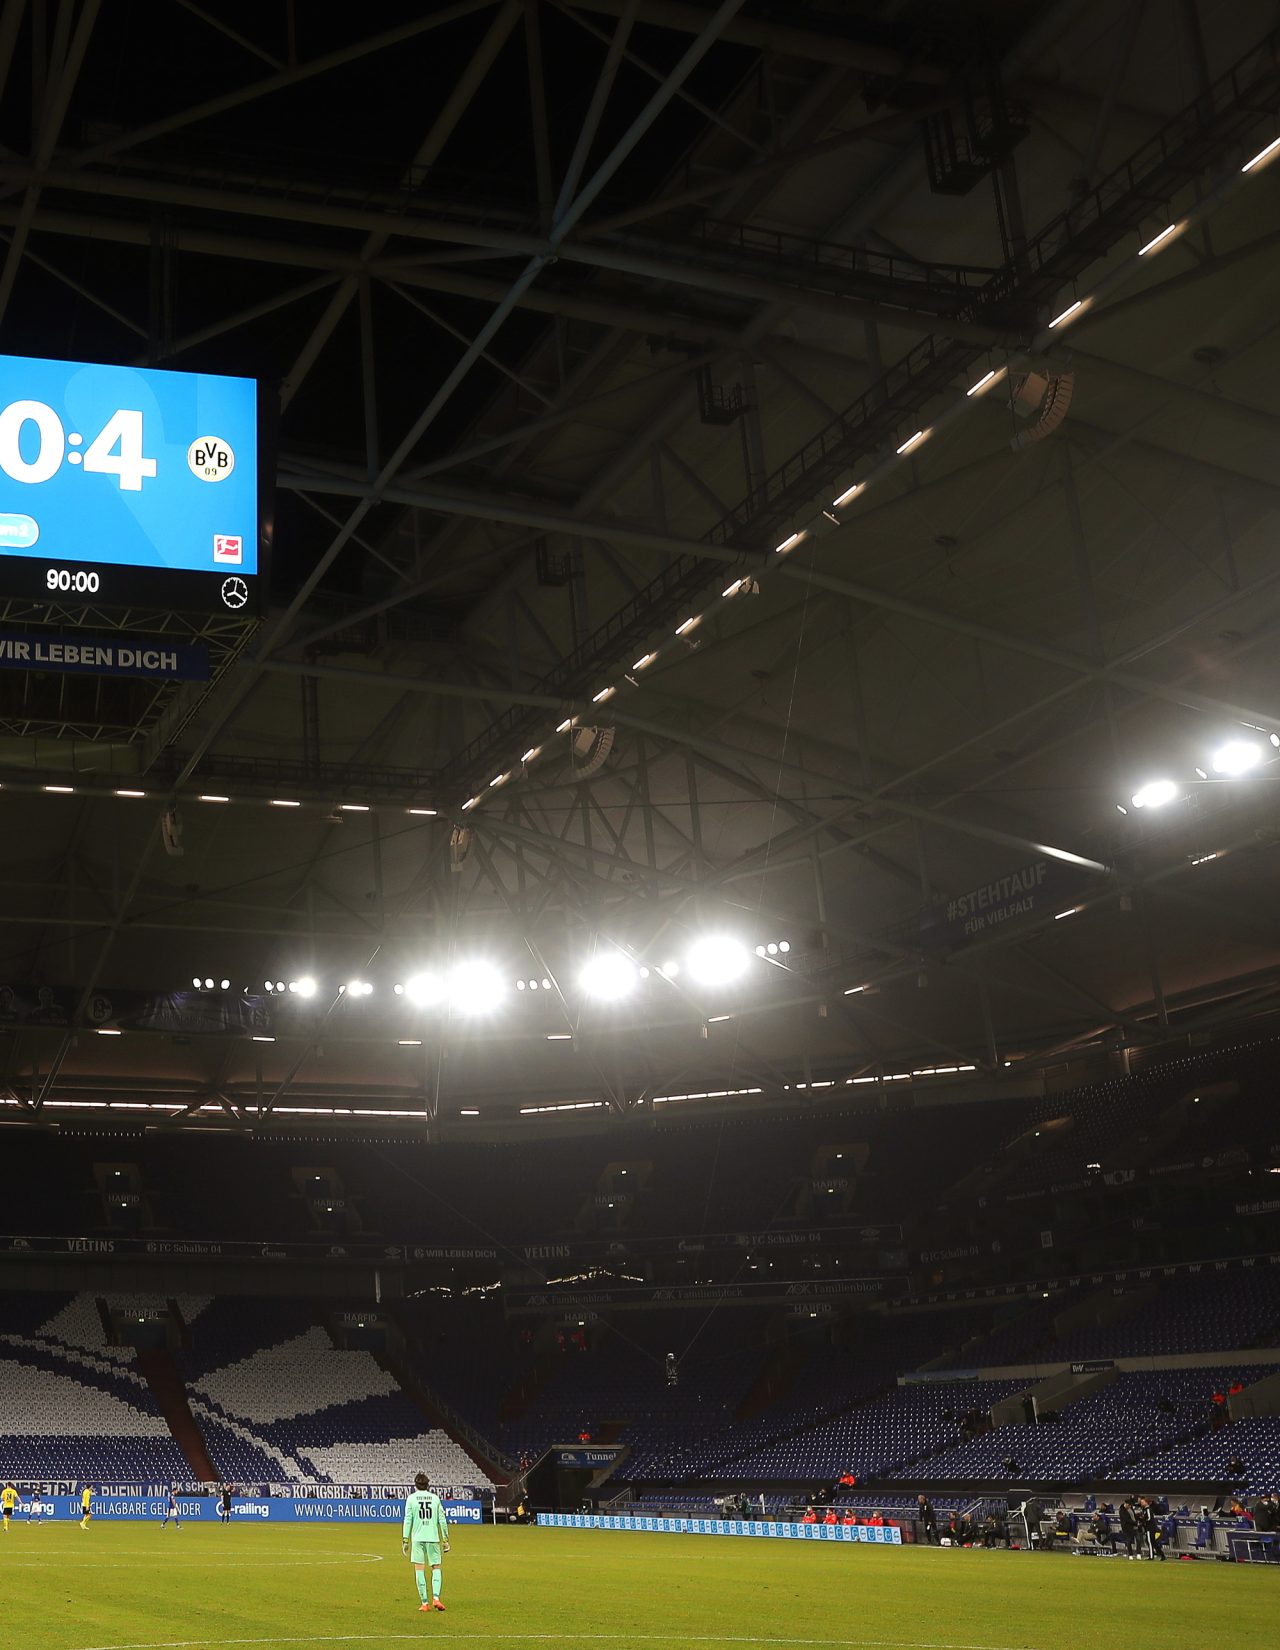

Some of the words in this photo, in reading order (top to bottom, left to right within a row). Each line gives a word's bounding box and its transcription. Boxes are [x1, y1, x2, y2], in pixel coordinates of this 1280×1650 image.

[195, 442, 228, 468] BVB
[204, 468, 218, 477] 09
[18, 524, 28, 536] 2
[46, 569, 100, 593] 90:00
[35, 643, 113, 666] LEBEN
[118, 649, 177, 671] DICH
[947, 862, 1047, 921] #STEHTAUF
[964, 916, 985, 935] FÜR
[987, 896, 1034, 925] VIELFALT
[67, 1239, 115, 1253] VELTINS
[159, 1243, 173, 1252] FC
[175, 1243, 208, 1254] Schalke
[525, 1245, 570, 1259] VELTINS
[426, 1249, 444, 1258] WIR
[445, 1249, 473, 1258] LEBEN
[474, 1249, 497, 1259] DICH
[678, 1287, 743, 1299] Familienblock
[814, 1282, 883, 1294] Familienblock
[551, 1294, 613, 1305] Familienblock
[124, 1310, 159, 1319] HARFID
[344, 1313, 378, 1323] HARFID
[371, 1485, 411, 1499] EICHEN
[70, 1502, 148, 1515] UNCHLAGBARE
[150, 1501, 201, 1516] GELNDER
[294, 1504, 402, 1519] WWW.Q-RAILING.COM
[418, 1501, 432, 1520] 35
[443, 1506, 480, 1520] -railing
